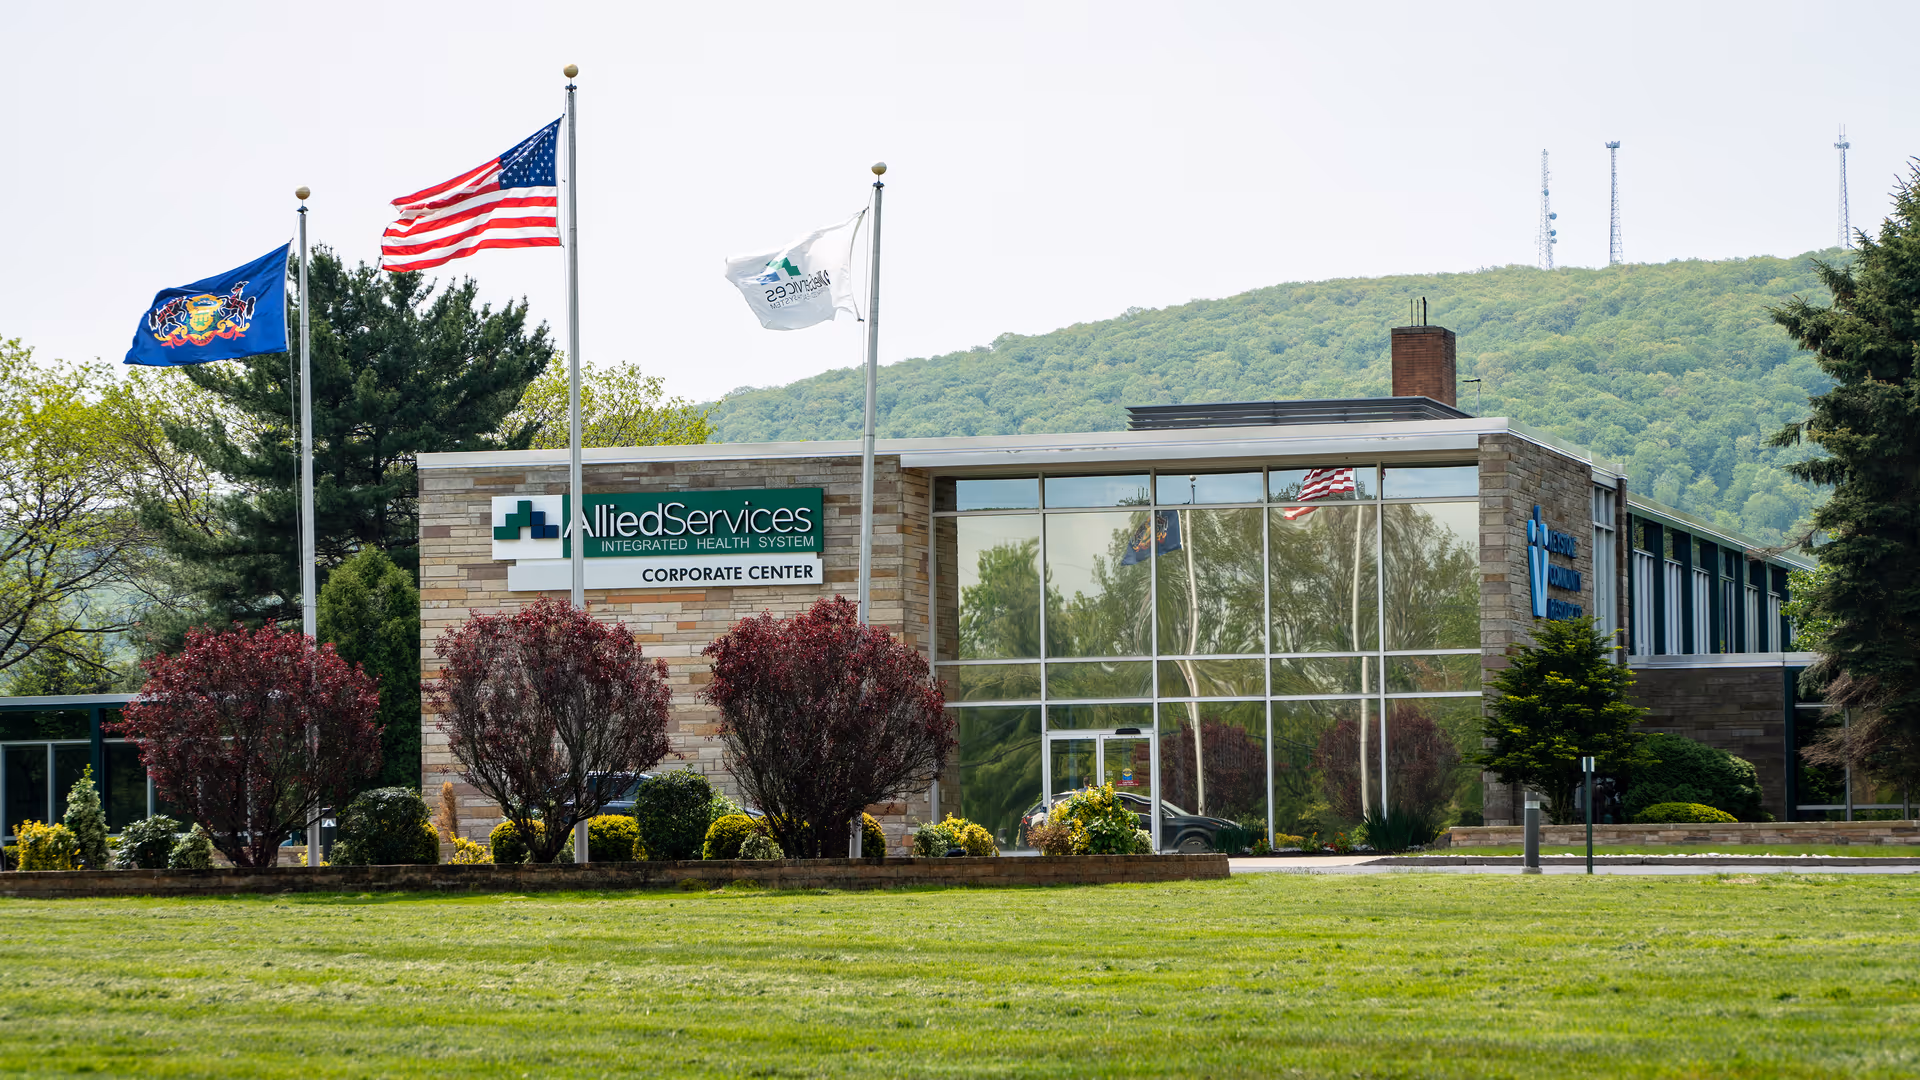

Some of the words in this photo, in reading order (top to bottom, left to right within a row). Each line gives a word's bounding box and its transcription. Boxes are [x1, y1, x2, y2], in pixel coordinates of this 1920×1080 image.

[601, 538, 688, 552] INTEGRATED
[696, 537, 750, 550] HEALTH
[758, 536, 815, 548] SYSTEM
[642, 567, 742, 582] CORPORATE
[748, 565, 814, 580] CENTER
